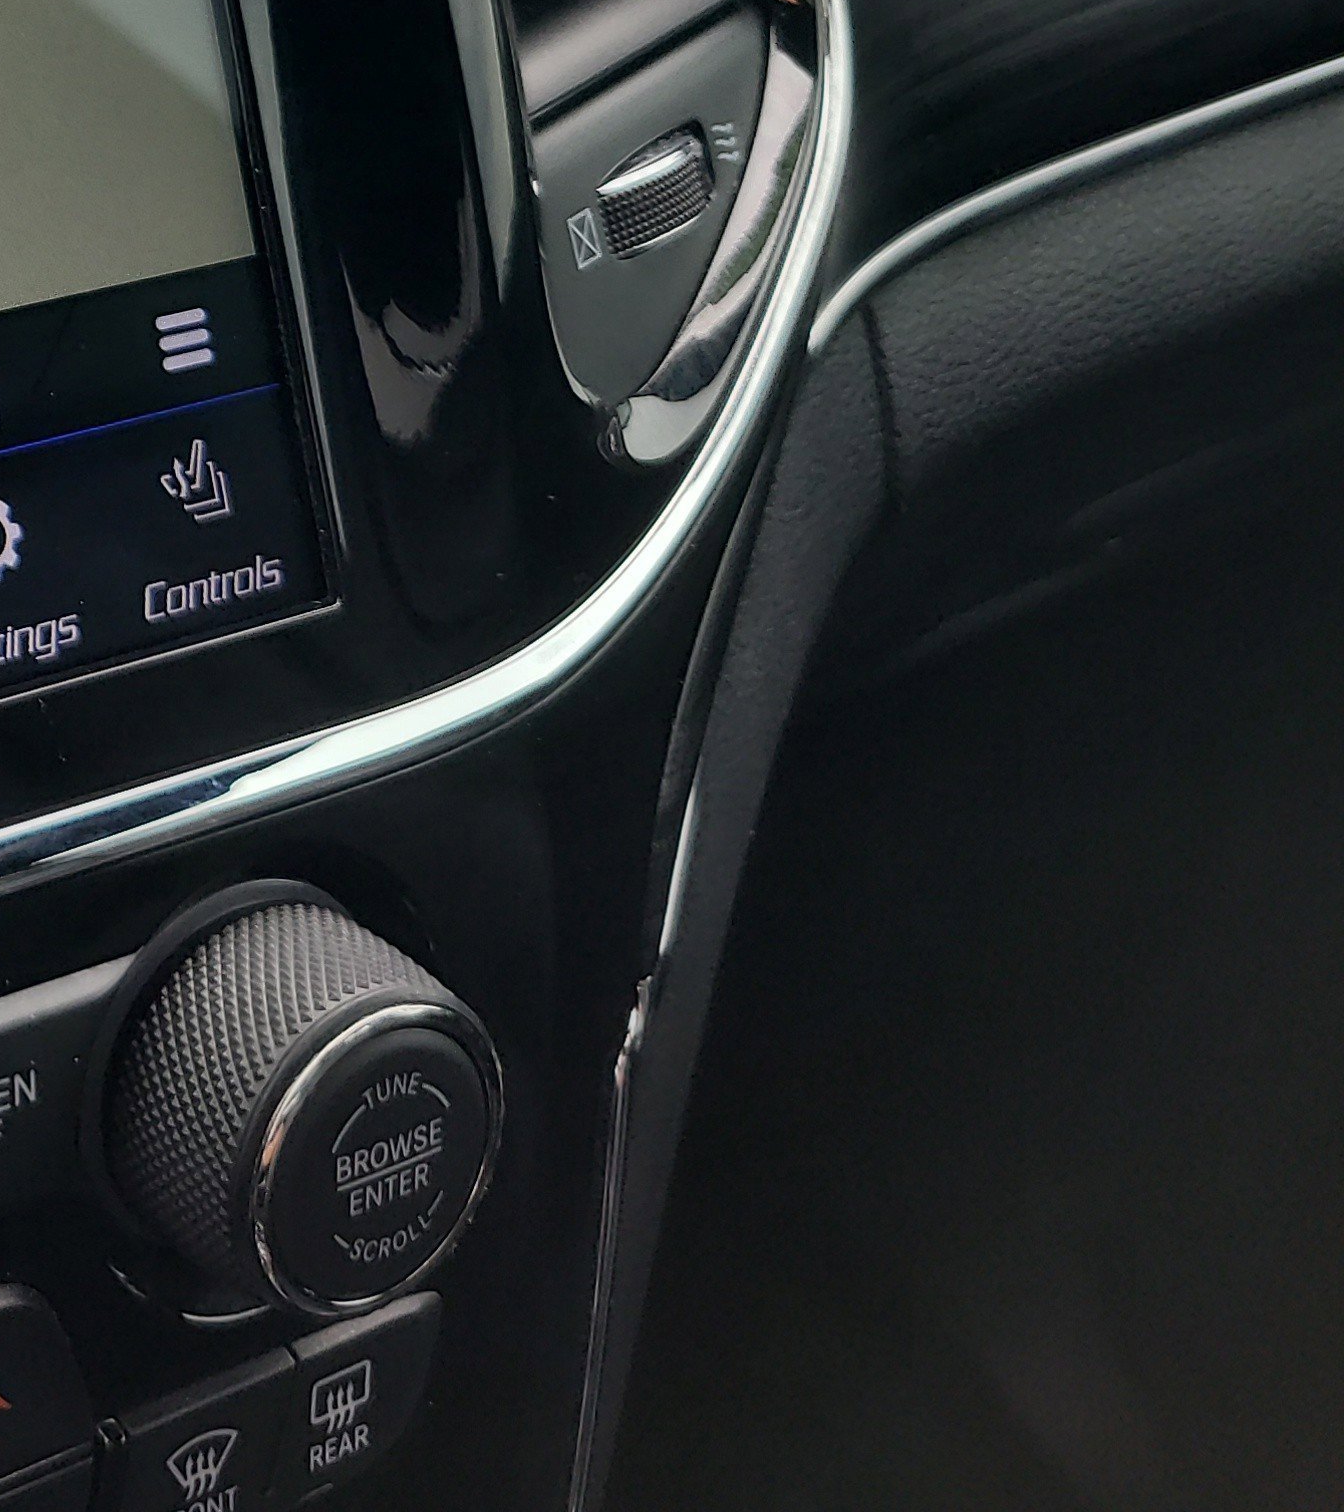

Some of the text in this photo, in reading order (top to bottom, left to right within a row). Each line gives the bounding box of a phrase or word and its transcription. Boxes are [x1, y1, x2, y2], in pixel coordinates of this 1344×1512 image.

[144, 554, 285, 624] Controls
[362, 1071, 423, 1110] TUNE
[336, 1116, 444, 1183] BROWSE
[349, 1162, 430, 1218] ENTER
[348, 1214, 433, 1263] SCROLL
[309, 1423, 370, 1473] REAR
